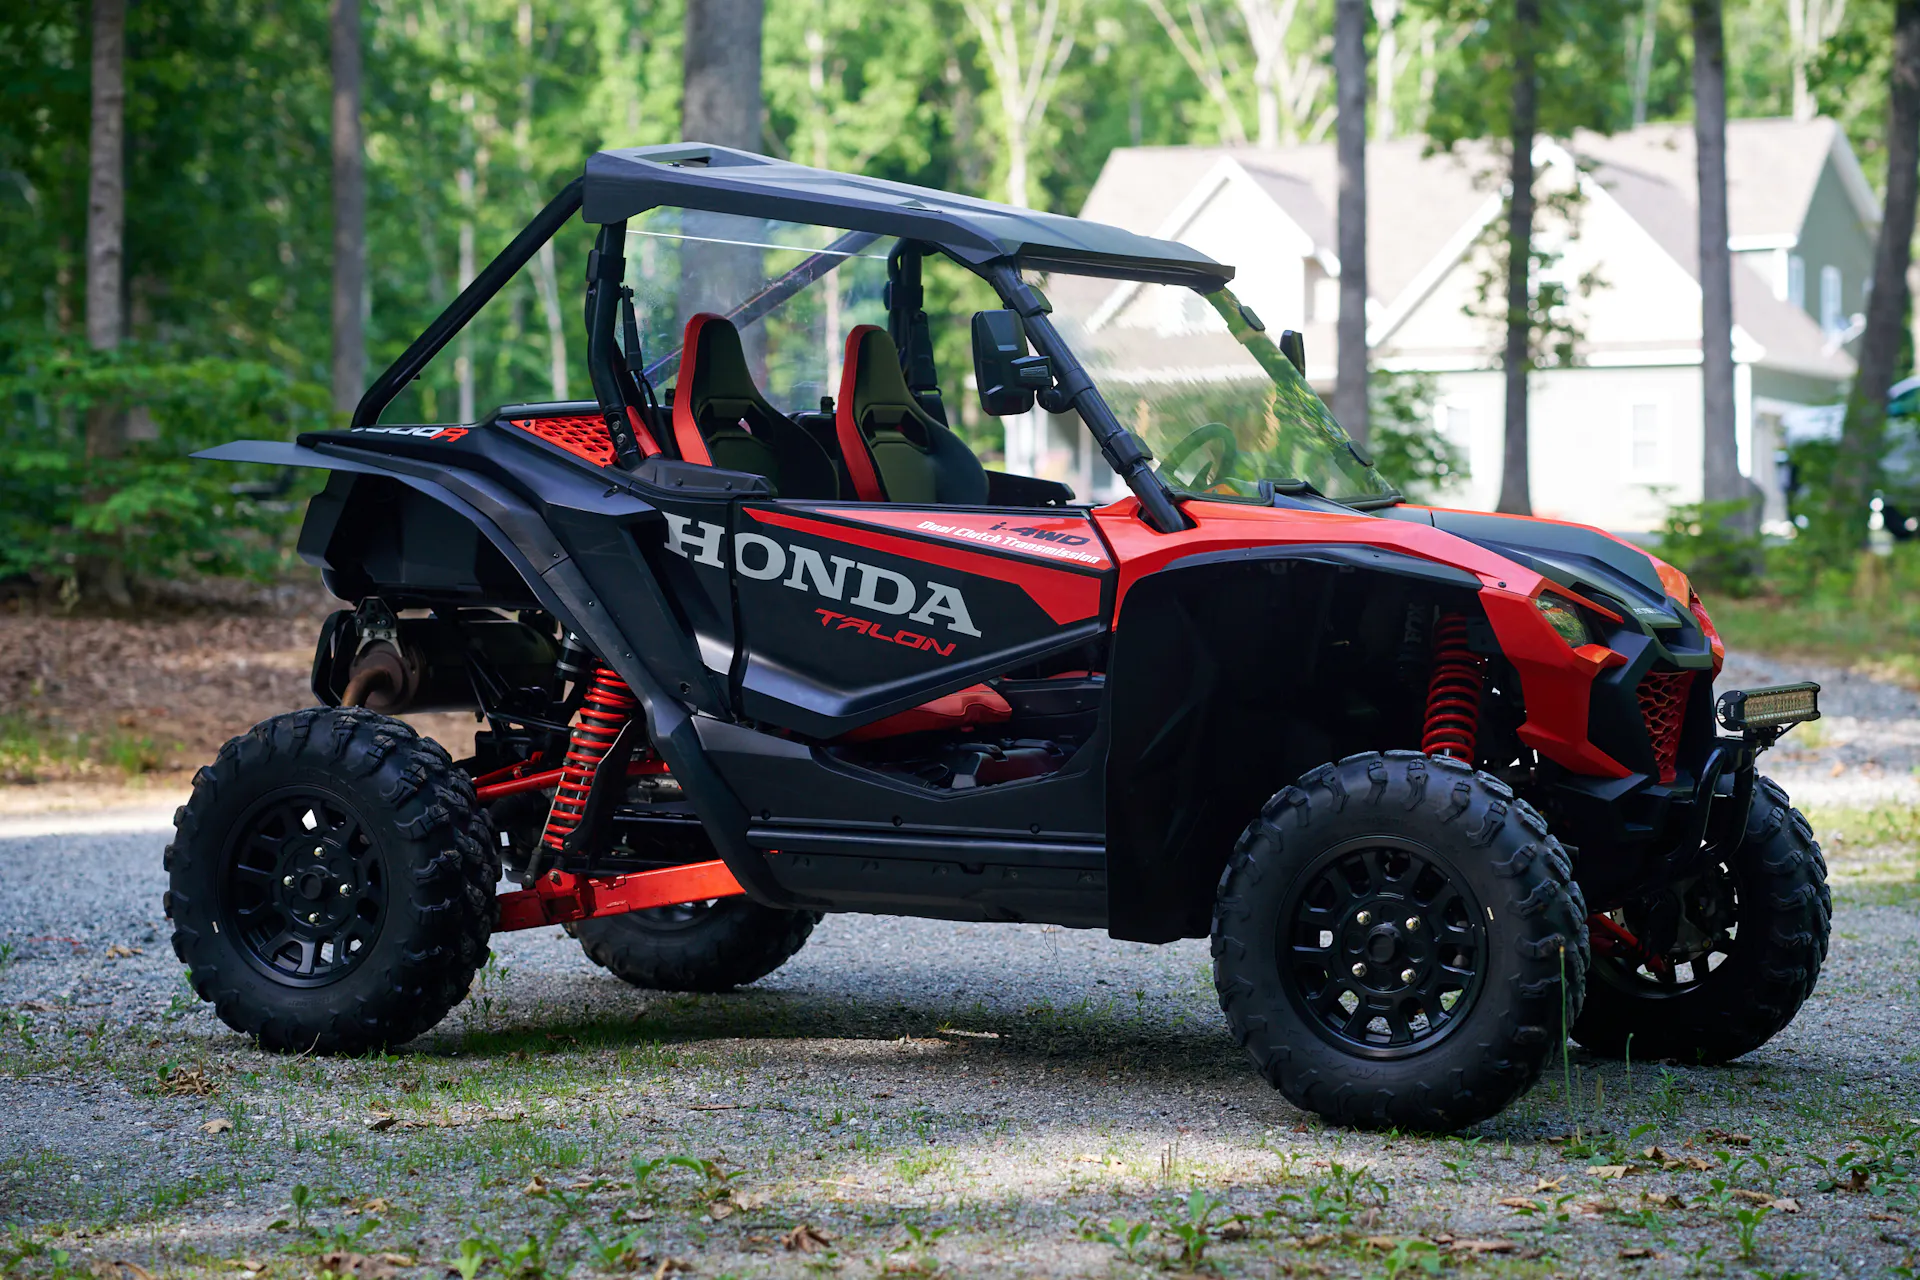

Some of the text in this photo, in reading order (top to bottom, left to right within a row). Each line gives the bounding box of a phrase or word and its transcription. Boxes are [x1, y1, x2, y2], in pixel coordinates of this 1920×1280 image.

[351, 427, 469, 442] 00R
[917, 521, 1101, 564] Dual Clutch Transmission
[989, 522, 1090, 546] i-4WD
[663, 512, 982, 638] HONDA
[815, 608, 956, 656] TALON
